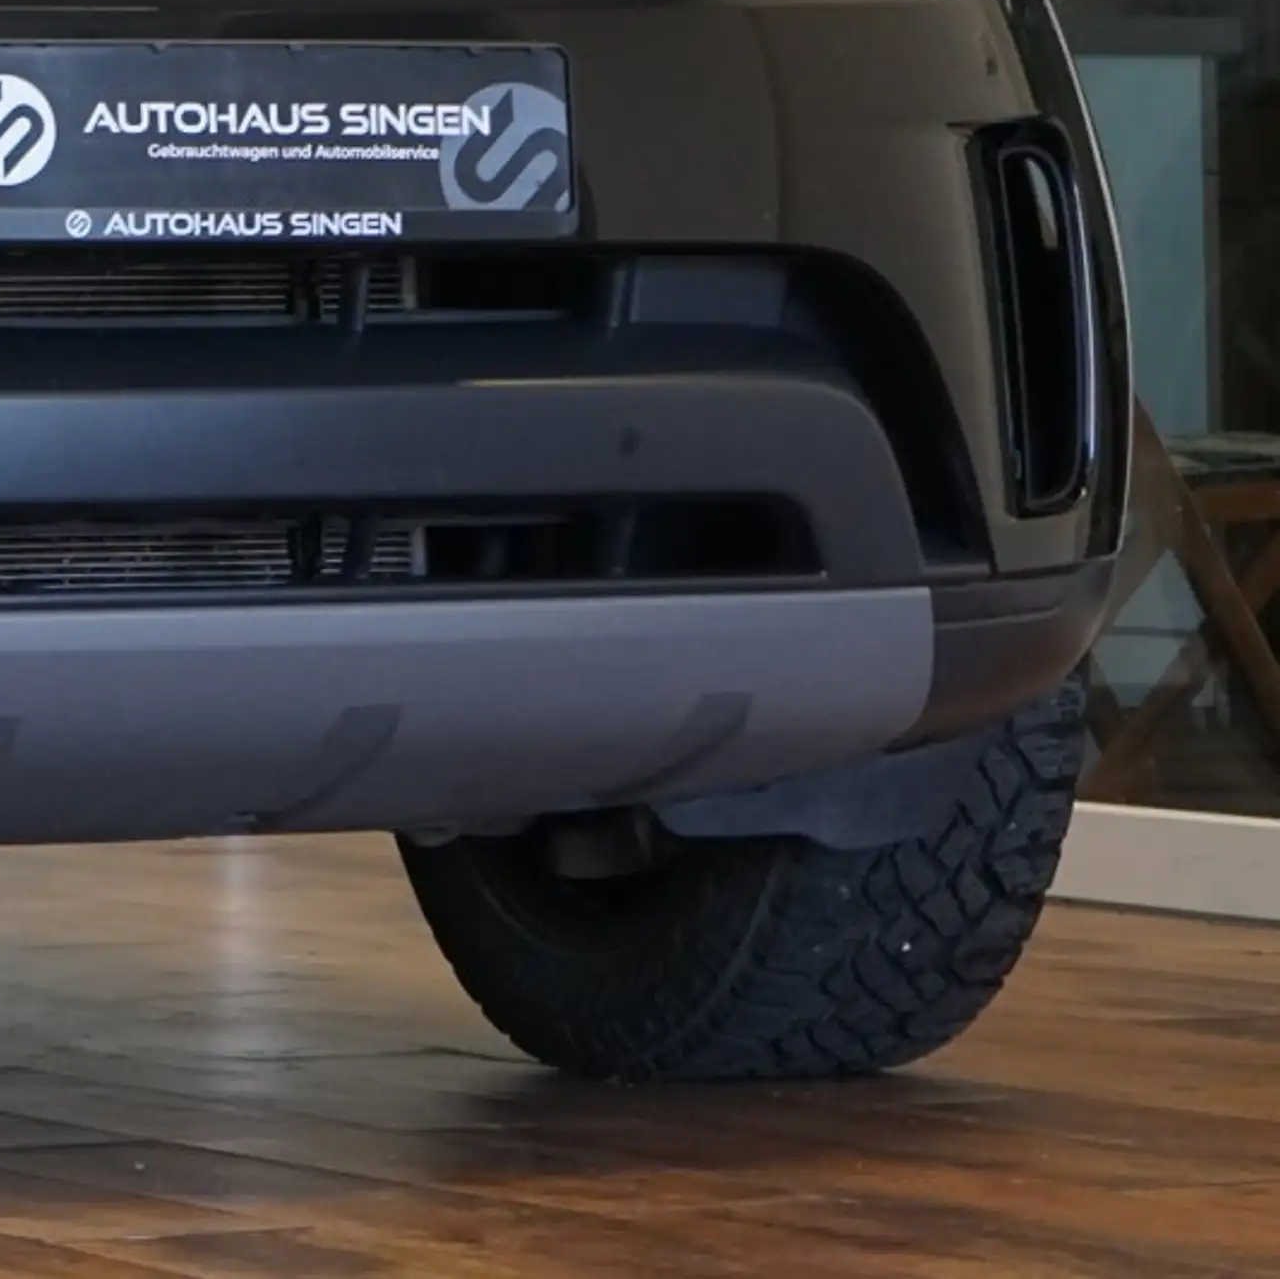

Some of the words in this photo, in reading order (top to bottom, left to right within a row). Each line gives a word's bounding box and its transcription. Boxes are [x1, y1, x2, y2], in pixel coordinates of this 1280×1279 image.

[83, 101, 331, 135] AUTOHAUS
[340, 103, 491, 136] SINGEN
[147, 142, 279, 163] Gebrauchtwagen
[282, 143, 312, 160] und
[314, 143, 440, 161] Automobilservice
[102, 211, 284, 237] AUTOHAUS
[290, 212, 402, 236] SINGEN
